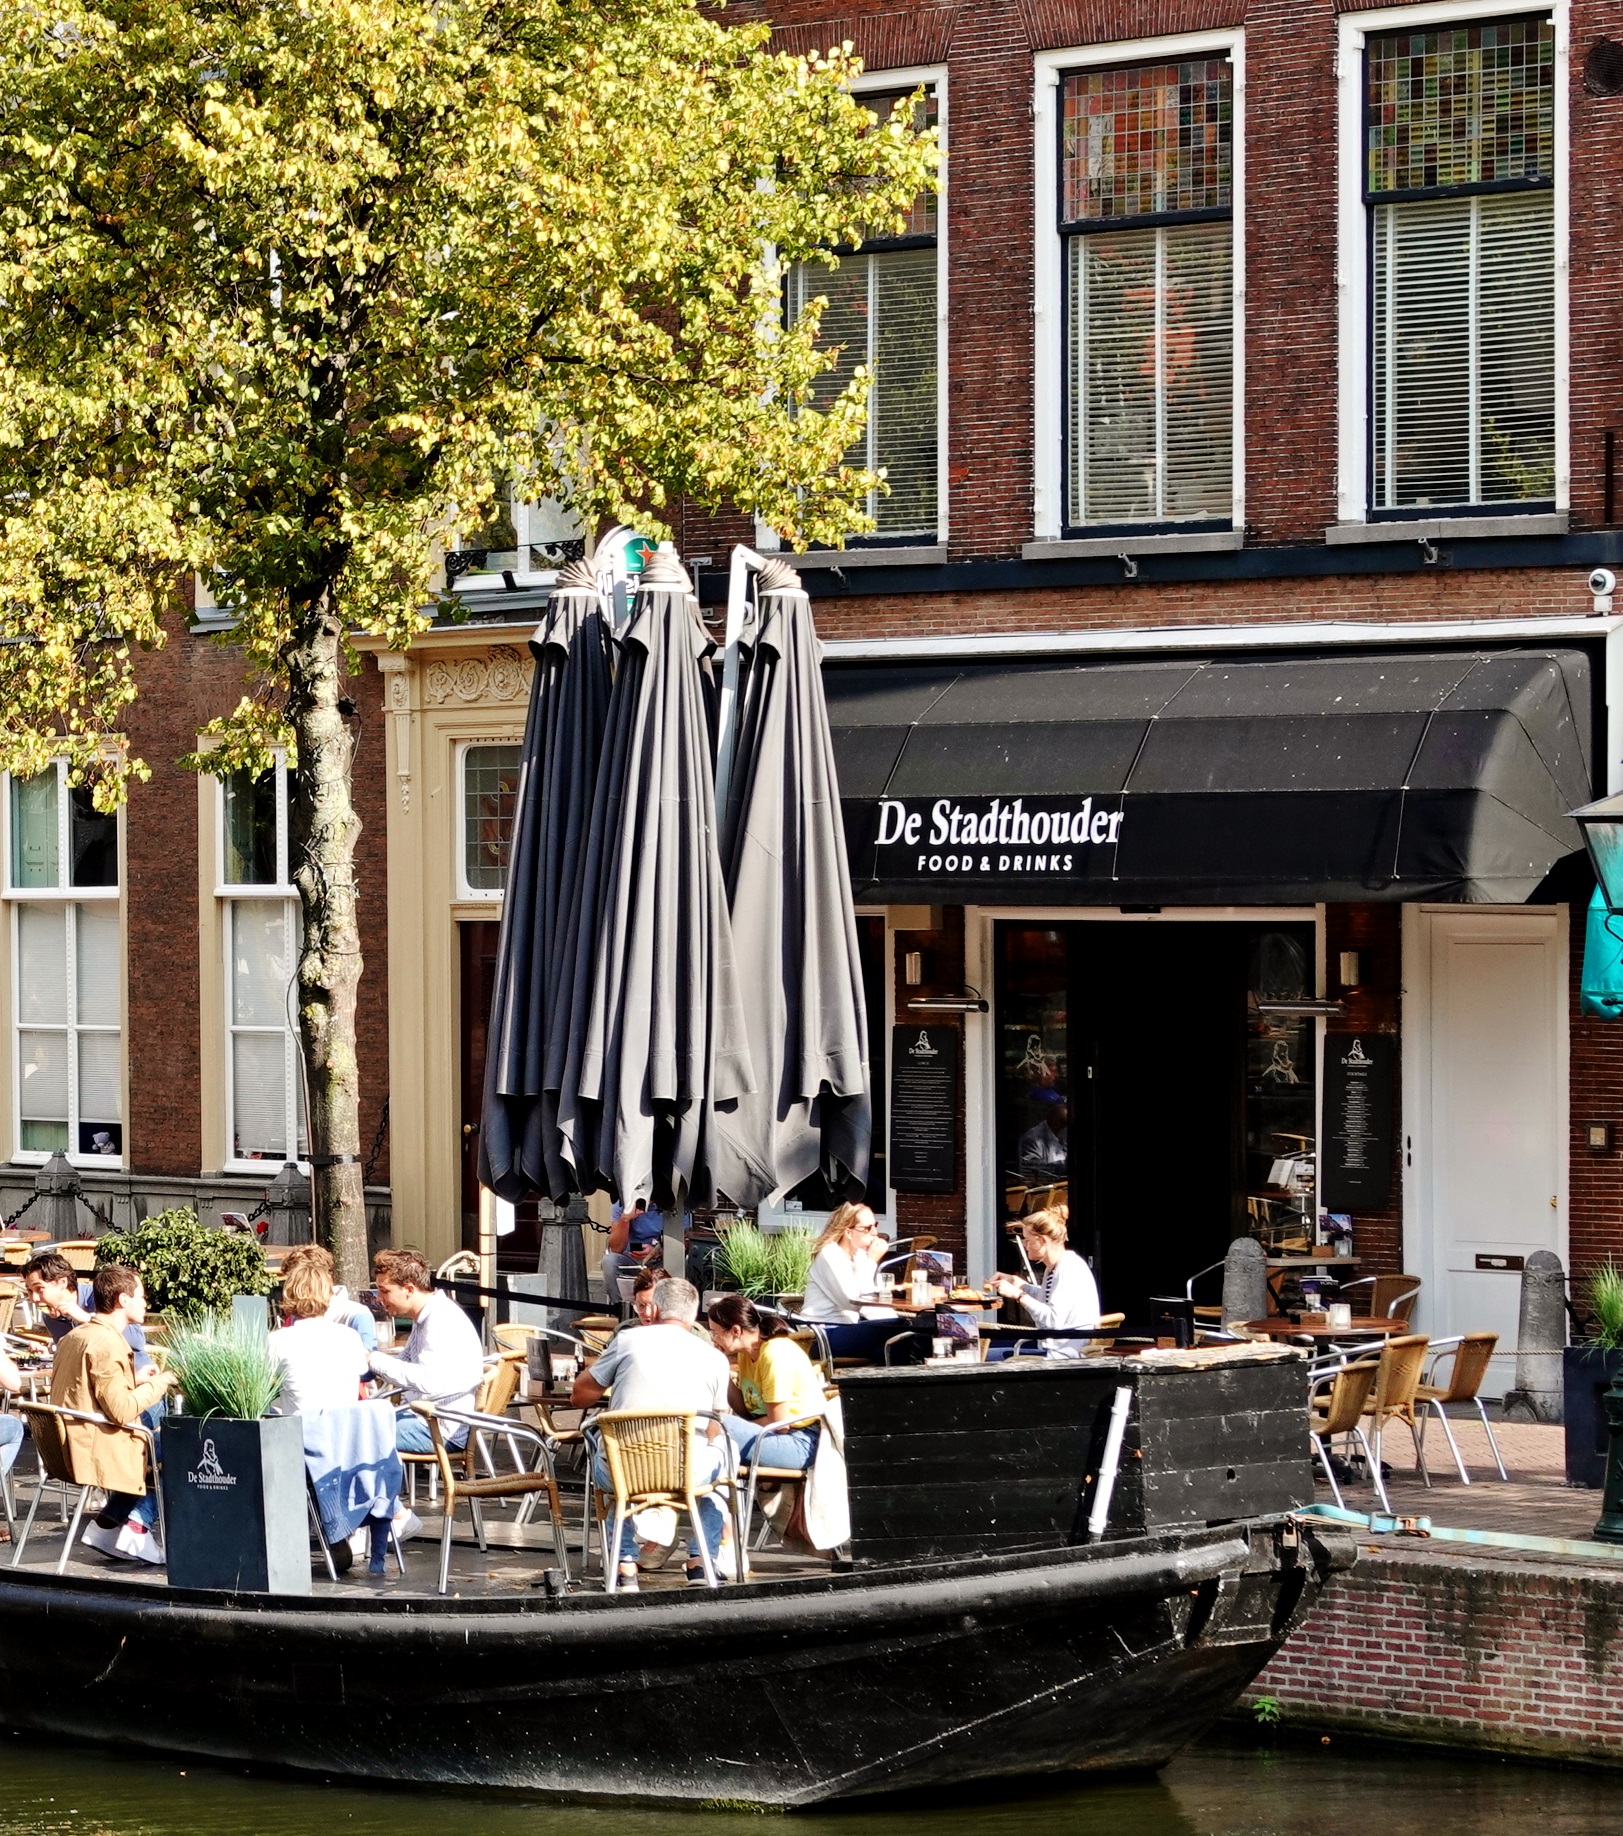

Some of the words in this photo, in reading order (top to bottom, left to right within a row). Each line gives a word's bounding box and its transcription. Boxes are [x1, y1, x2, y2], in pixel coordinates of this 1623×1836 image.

[874, 800, 923, 846] De
[929, 797, 1124, 845] Stadthouder
[918, 855, 973, 871] FOOD
[980, 856, 991, 871] &
[999, 855, 1073, 871] DRINKS
[187, 1471, 198, 1483] De
[198, 1471, 237, 1485] Stadthouder
